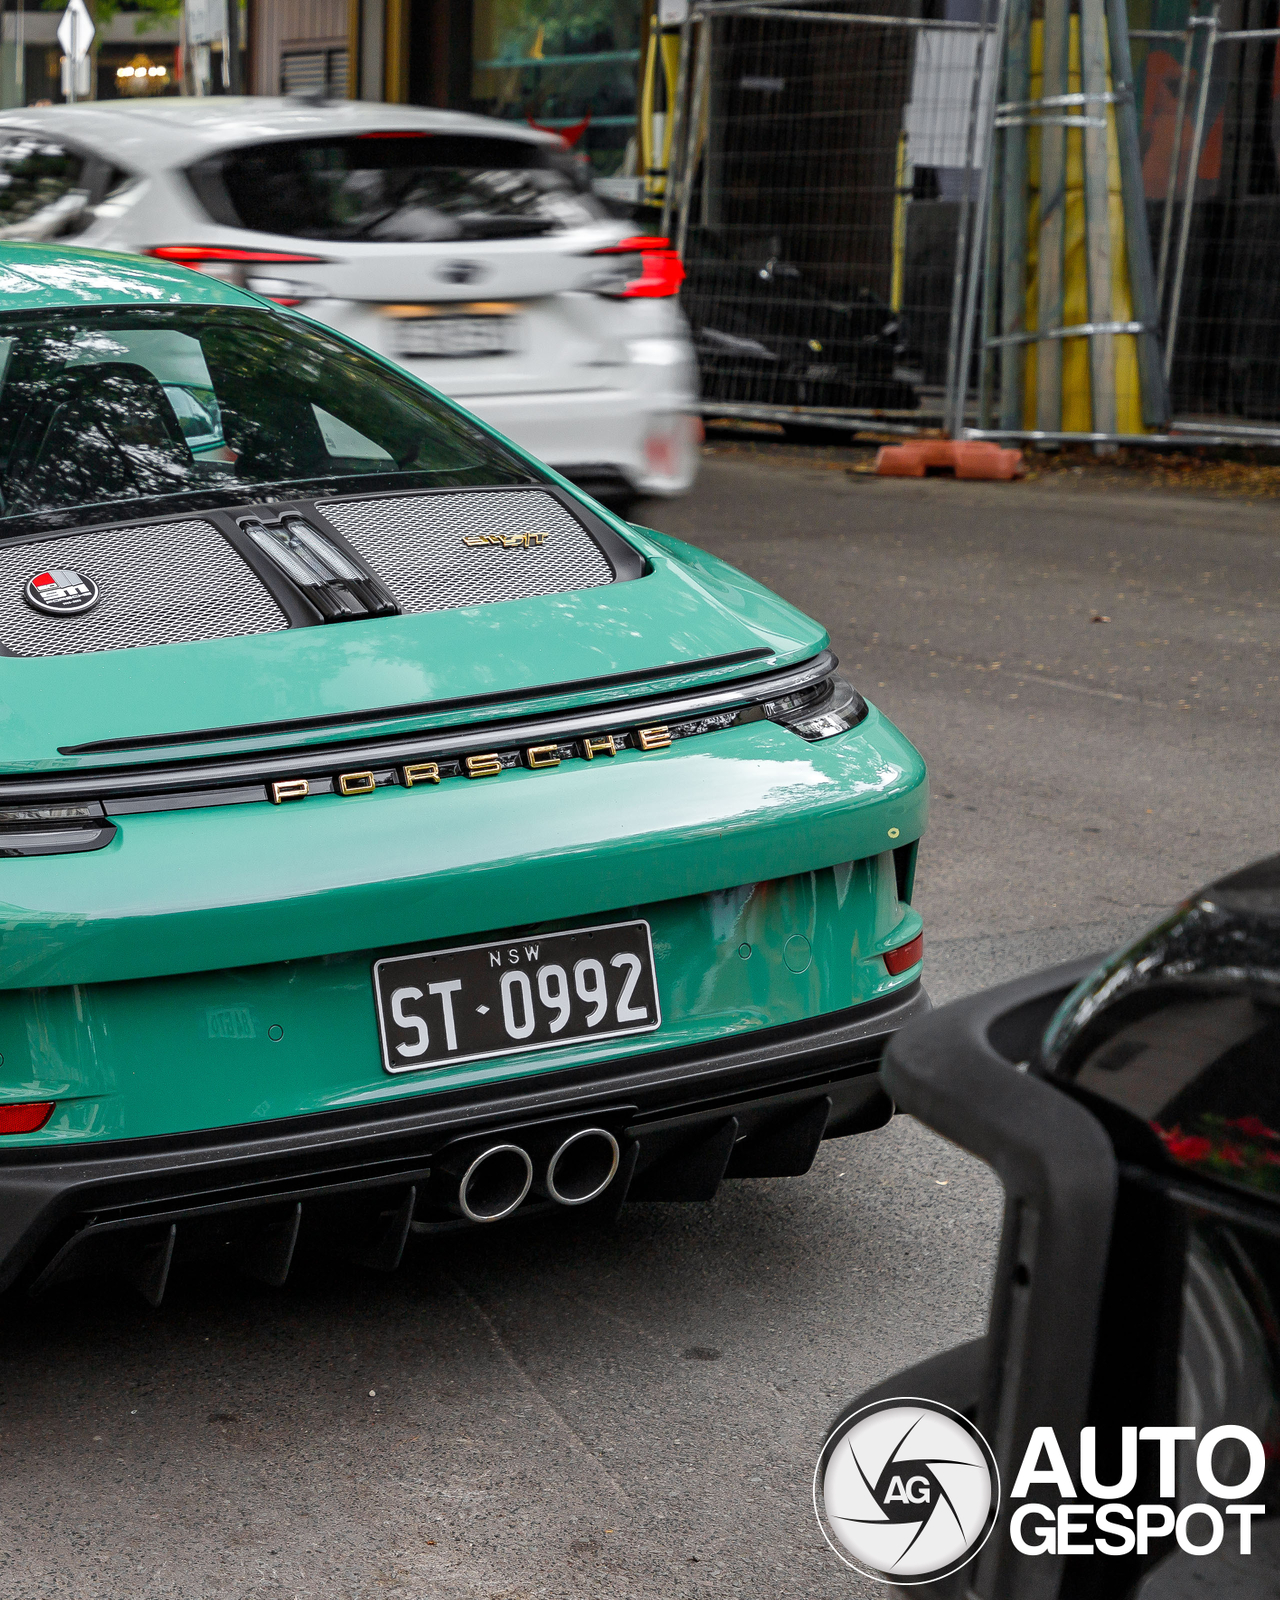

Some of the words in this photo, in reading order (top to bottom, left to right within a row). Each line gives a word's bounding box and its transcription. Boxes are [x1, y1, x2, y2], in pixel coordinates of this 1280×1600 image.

[272, 726, 672, 803] PORSCHE
[489, 943, 540, 967] NSW
[391, 980, 462, 1057] ST
[500, 953, 648, 1040] 0992
